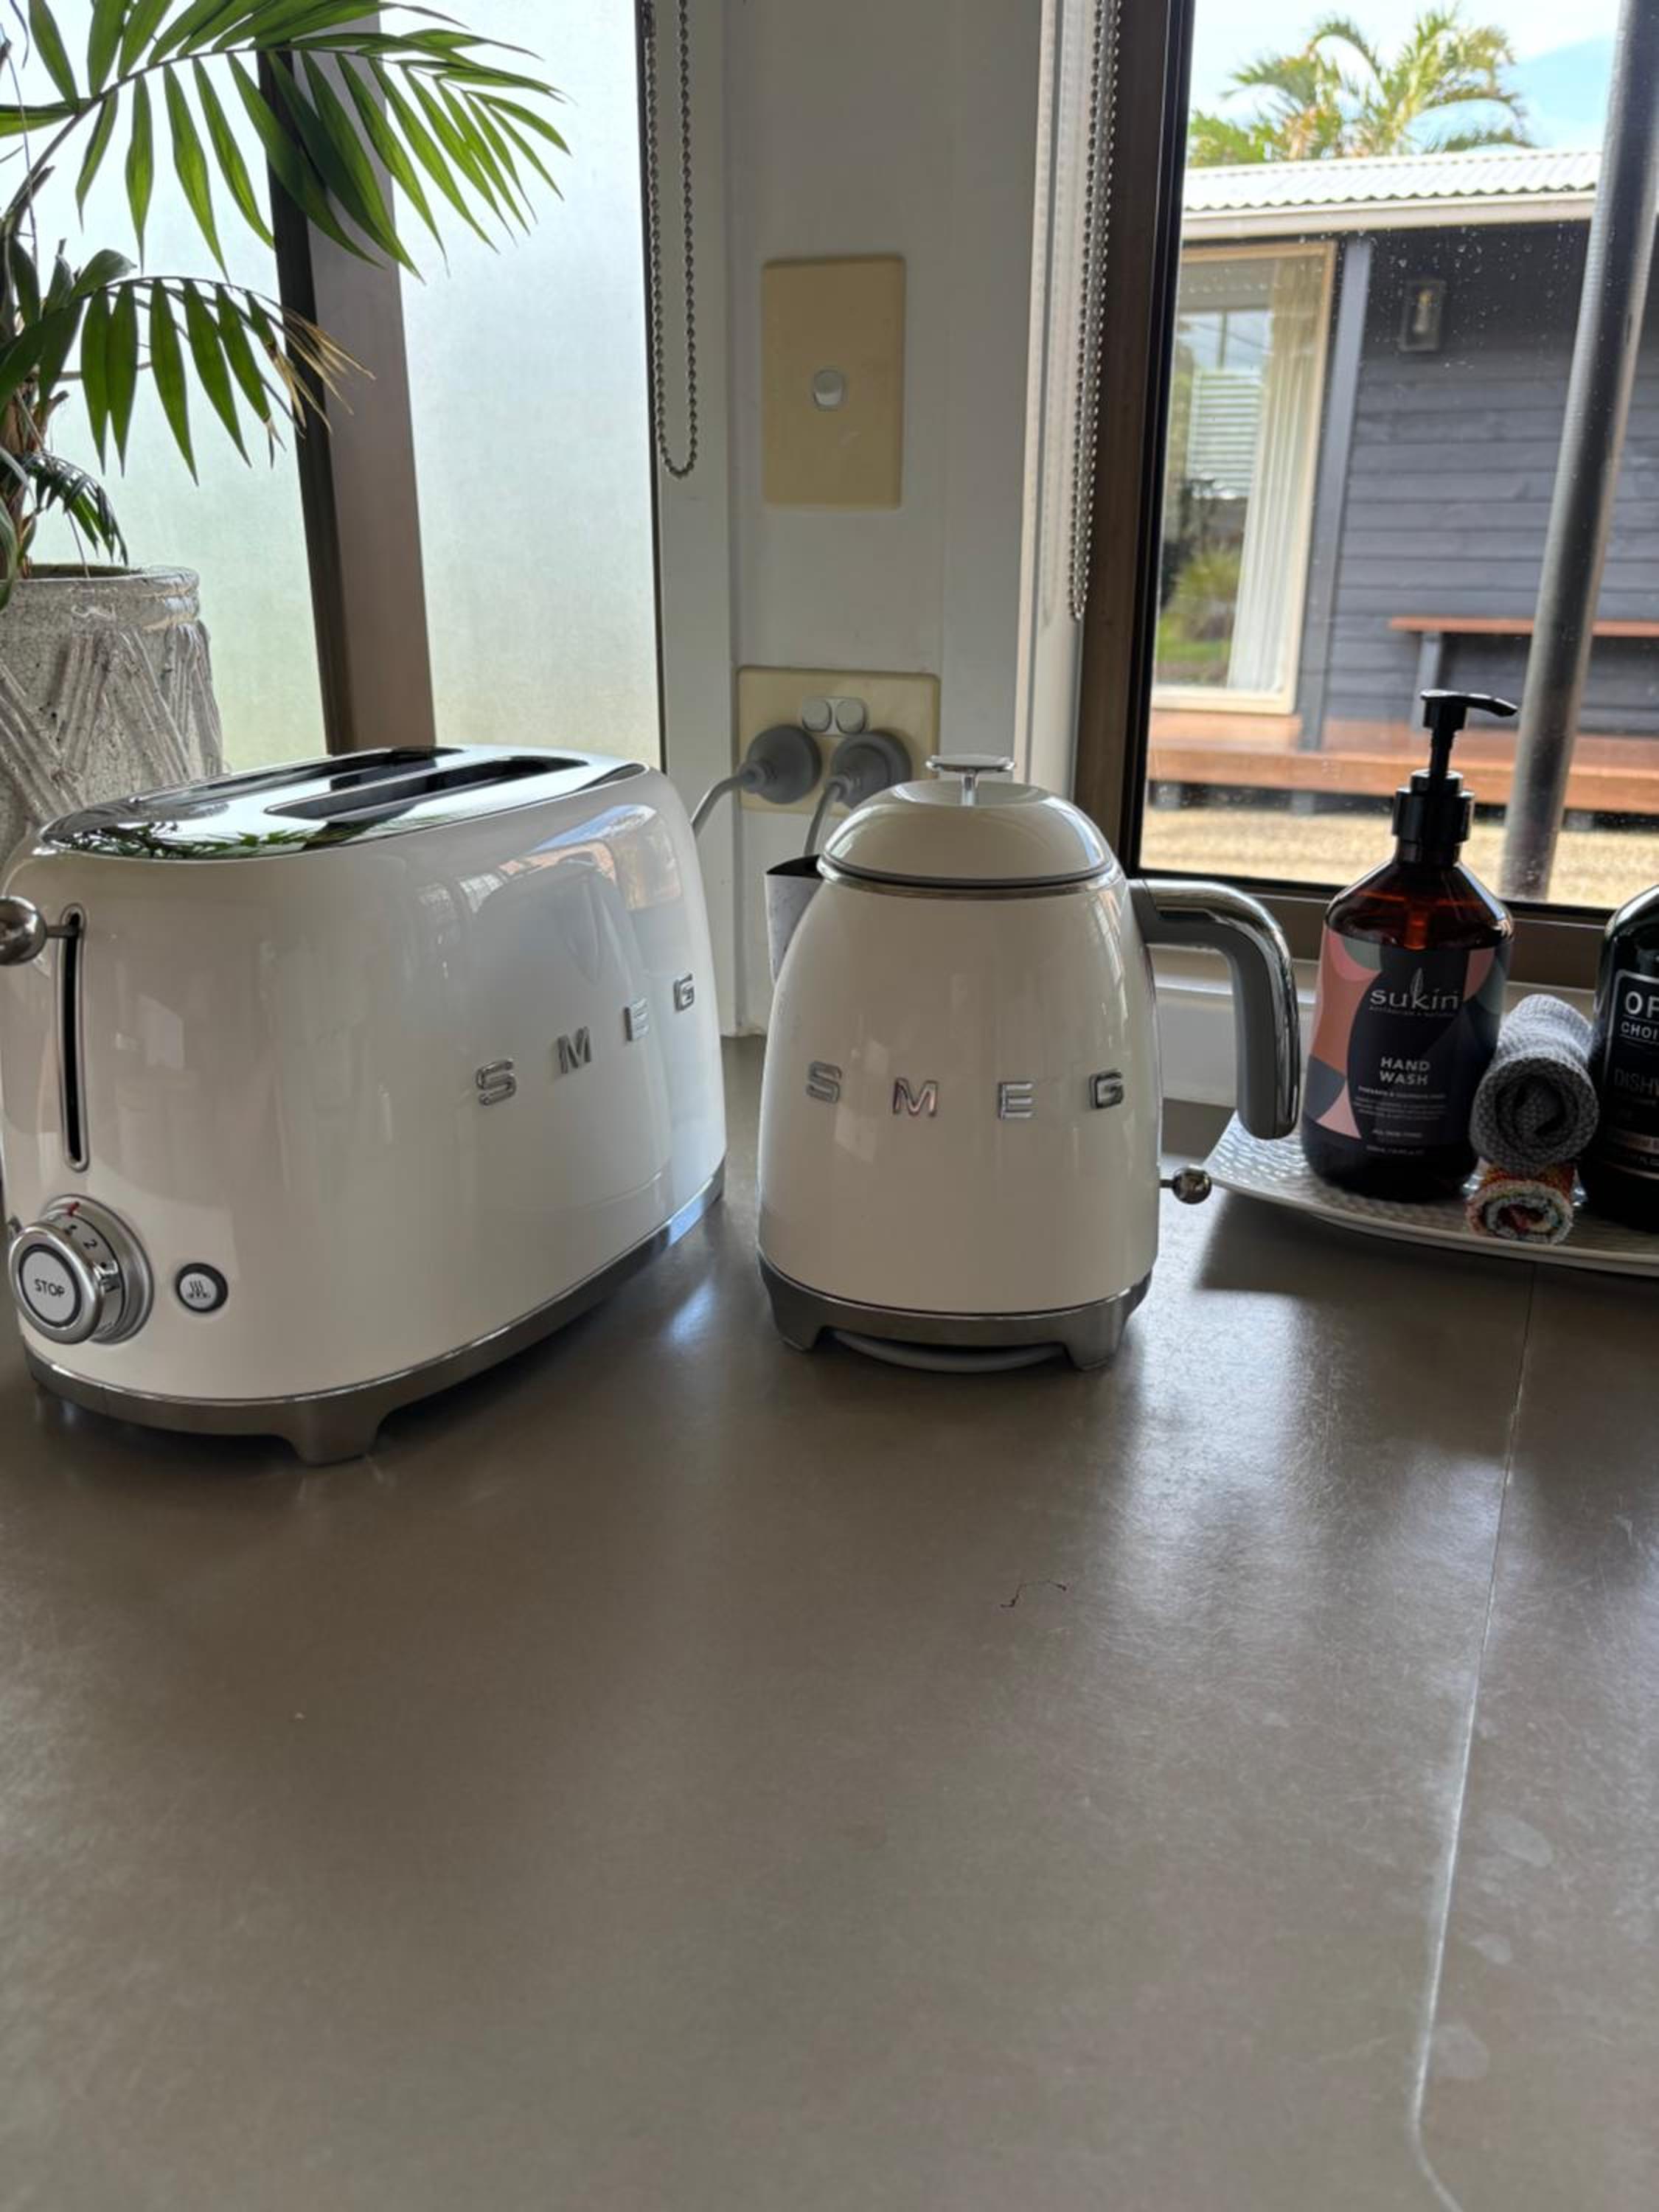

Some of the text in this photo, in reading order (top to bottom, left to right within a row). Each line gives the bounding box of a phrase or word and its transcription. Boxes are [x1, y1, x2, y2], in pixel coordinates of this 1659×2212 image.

[1369, 968, 1459, 1010] sukin
[476, 973, 695, 1106] SMEG
[1379, 1070, 1429, 1086] WASH
[1380, 1056, 1430, 1072] HAND
[806, 1061, 1123, 1119] SMEG
[34, 1278, 65, 1298] STOP
